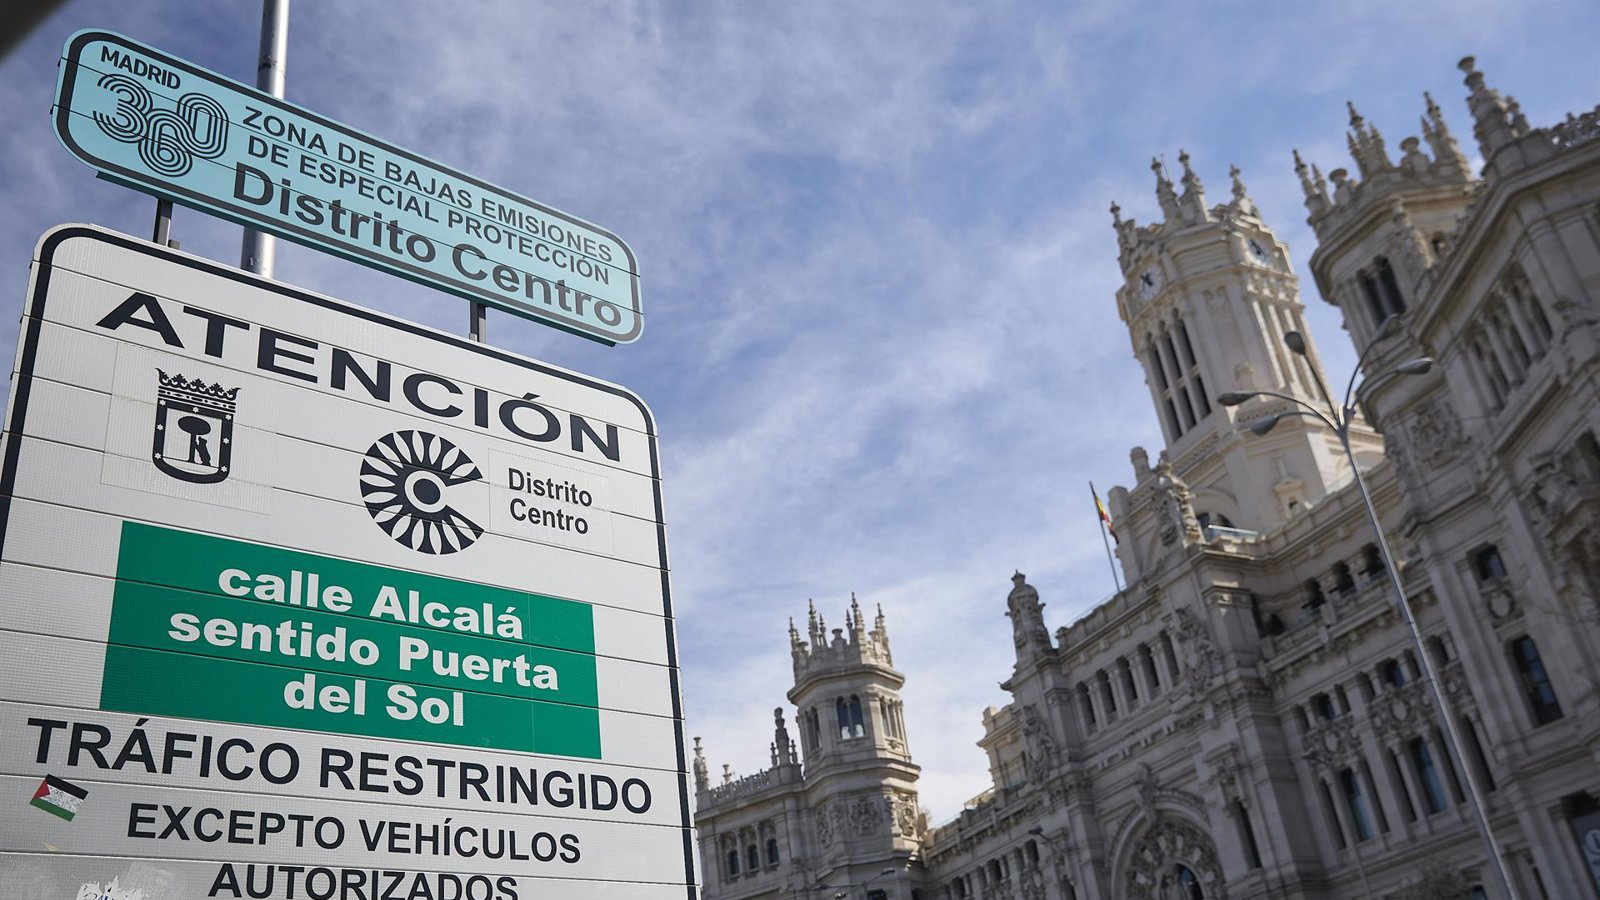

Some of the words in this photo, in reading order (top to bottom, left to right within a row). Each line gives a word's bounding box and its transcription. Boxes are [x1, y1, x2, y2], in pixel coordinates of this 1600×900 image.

[101, 45, 181, 90] MADRID
[93, 74, 230, 177] 360
[243, 105, 329, 156] ZONA
[338, 142, 375, 174] DE
[385, 160, 473, 209] BAJAS
[482, 198, 613, 263] EMISIONES
[248, 135, 290, 169] DE
[299, 154, 439, 223] ESPECIAL
[448, 210, 609, 285] PROTECCIÓN
[234, 161, 436, 263] Distrito
[451, 244, 621, 327] Centro
[95, 291, 620, 462] ATENCIÓN
[508, 467, 593, 507] Distrito
[509, 498, 589, 534] Centro
[218, 568, 353, 613] calle
[369, 585, 523, 640] Alcalá
[168, 613, 380, 666] sentido
[399, 636, 559, 691] Puerta
[283, 673, 366, 716] del
[385, 684, 464, 727] Sol
[27, 717, 300, 785] TRÁFICO
[319, 747, 652, 814] RESTRINGIDO
[127, 802, 345, 850] EXCEPTO
[358, 818, 581, 864] VEHÍCULOS
[207, 862, 519, 900] AUTORIZADOS
